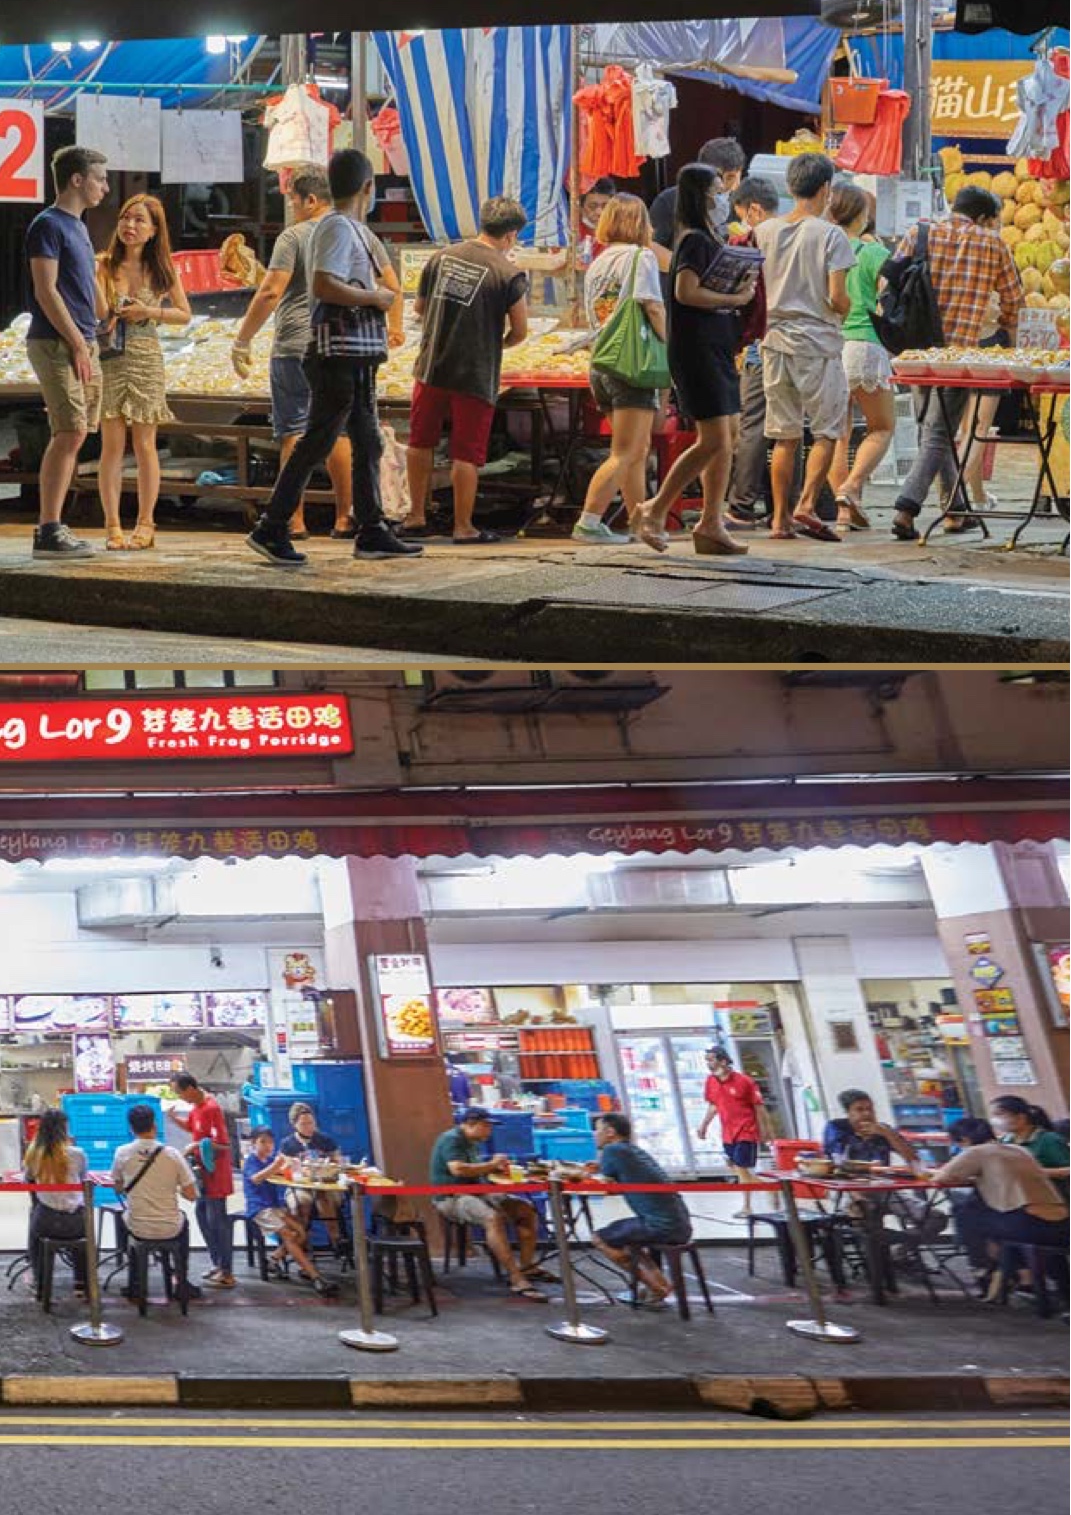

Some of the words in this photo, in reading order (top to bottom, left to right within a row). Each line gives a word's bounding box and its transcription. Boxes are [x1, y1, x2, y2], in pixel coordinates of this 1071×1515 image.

[147, 734, 200, 749] Fresh
[208, 734, 251, 750] Frog
[258, 732, 342, 748] Porridge
[587, 823, 677, 848] Geylang
